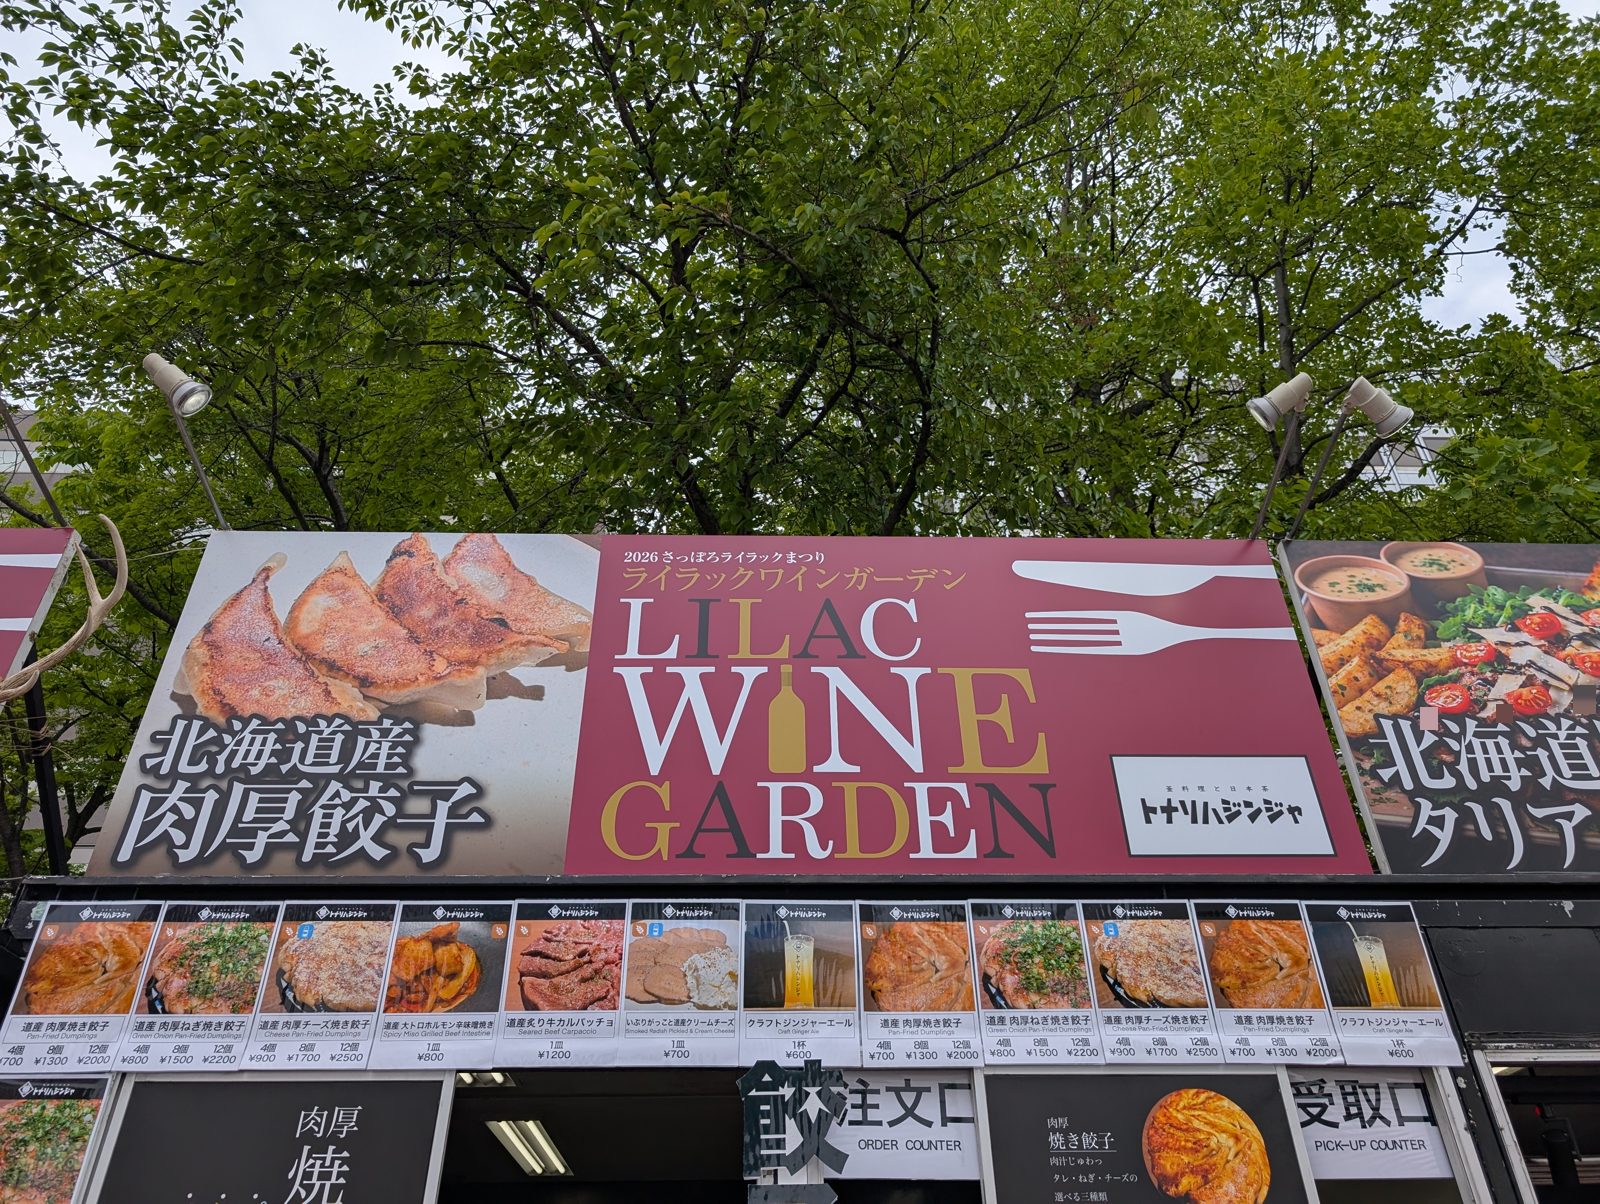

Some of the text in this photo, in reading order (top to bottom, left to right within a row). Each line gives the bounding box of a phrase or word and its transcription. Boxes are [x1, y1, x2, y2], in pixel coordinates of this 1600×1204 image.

[624, 551, 825, 564] 2026 さっぽろライラックまつり
[623, 565, 966, 592] ライラックワインガーデン
[614, 598, 921, 661] LILAC
[145, 718, 414, 776] 北海道産
[1368, 717, 1600, 791] 北海道
[1140, 798, 1303, 824] トナリハジンジャ
[117, 779, 485, 864] 肉厚餃子
[601, 780, 1056, 861] GARDEN
[1412, 797, 1592, 869] タリア
[259, 1020, 370, 1030] 道産 肉厚チーズ焼き餃子
[506, 1018, 614, 1028] 道産炙り牛カルパッチョ
[747, 1018, 853, 1027] クラフトジンジャーエール
[880, 1018, 962, 1028] 道産 肉厚焼き餃子
[986, 1015, 1091, 1026] 道産 肉厚ねぎ焼き餃子
[1103, 1015, 1208, 1025] 道産 肉厚チーズ焼き餃子
[1234, 1015, 1315, 1026] 道産 肉厚焼き餃子
[1340, 1018, 1443, 1027] クラフトジンジャーエール
[21, 1022, 109, 1032] 道産 肉厚焼き餃子
[134, 1021, 246, 1032] 道産 肉厚ねぎ焼き餃子
[61, 1033, 97, 1041] Dumplings
[248, 1054, 363, 1062] ¥900 ¥1700 ¥2500
[417, 1053, 444, 1062] ¥800
[538, 1050, 571, 1059] ¥1200
[663, 1050, 690, 1059] ¥700
[785, 1050, 811, 1059] ¥600
[869, 1052, 979, 1060] ¥700 ¥1300 ¥2000
[990, 1048, 1099, 1057] ¥800 ¥1500 ¥2200
[1110, 1048, 1218, 1057] ¥900 ¥1700 ¥2500
[1230, 1048, 1337, 1057] ¥700 ¥1300 ¥2000
[1388, 1049, 1414, 1058] ¥600
[34, 1057, 68, 1066] ¥1300
[77, 1056, 110, 1065] ¥2000
[120, 1056, 236, 1064] ¥800 ¥1500 ¥2200
[836, 1077, 974, 1128] 注文口
[1290, 1078, 1438, 1129] 受取口
[296, 1106, 363, 1138] 肉厚
[1047, 1117, 1069, 1129] 肉厚
[858, 1139, 962, 1151] ORDER COUNTER
[1048, 1132, 1114, 1150] 焼き餃子
[1314, 1139, 1427, 1151] PICK-UP COUNTER
[284, 1145, 350, 1204] 焼
[1054, 1191, 1108, 1202] 選べる三種類
